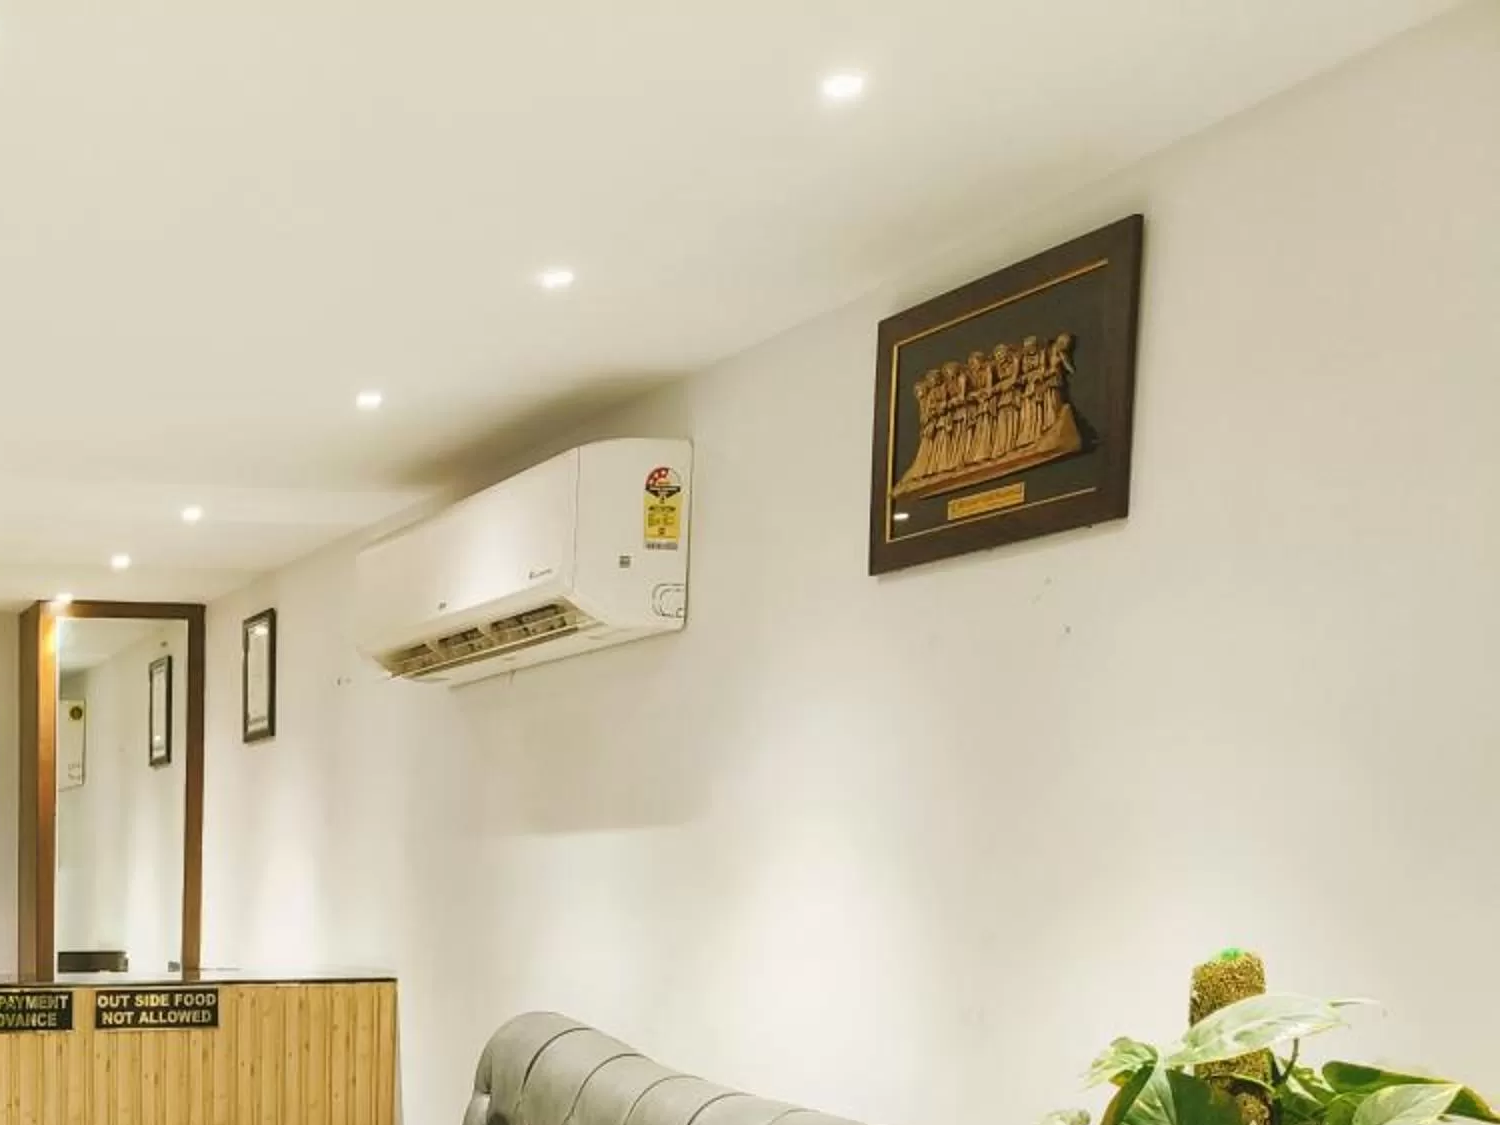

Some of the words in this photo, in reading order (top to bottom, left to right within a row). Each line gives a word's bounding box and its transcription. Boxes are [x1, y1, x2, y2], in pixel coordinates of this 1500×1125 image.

[97, 995, 130, 1008] OUT
[134, 994, 170, 1007] SIDE
[174, 993, 217, 1007] FOOD
[102, 1011, 135, 1025] NOT
[139, 1009, 212, 1024] ALLOWED
